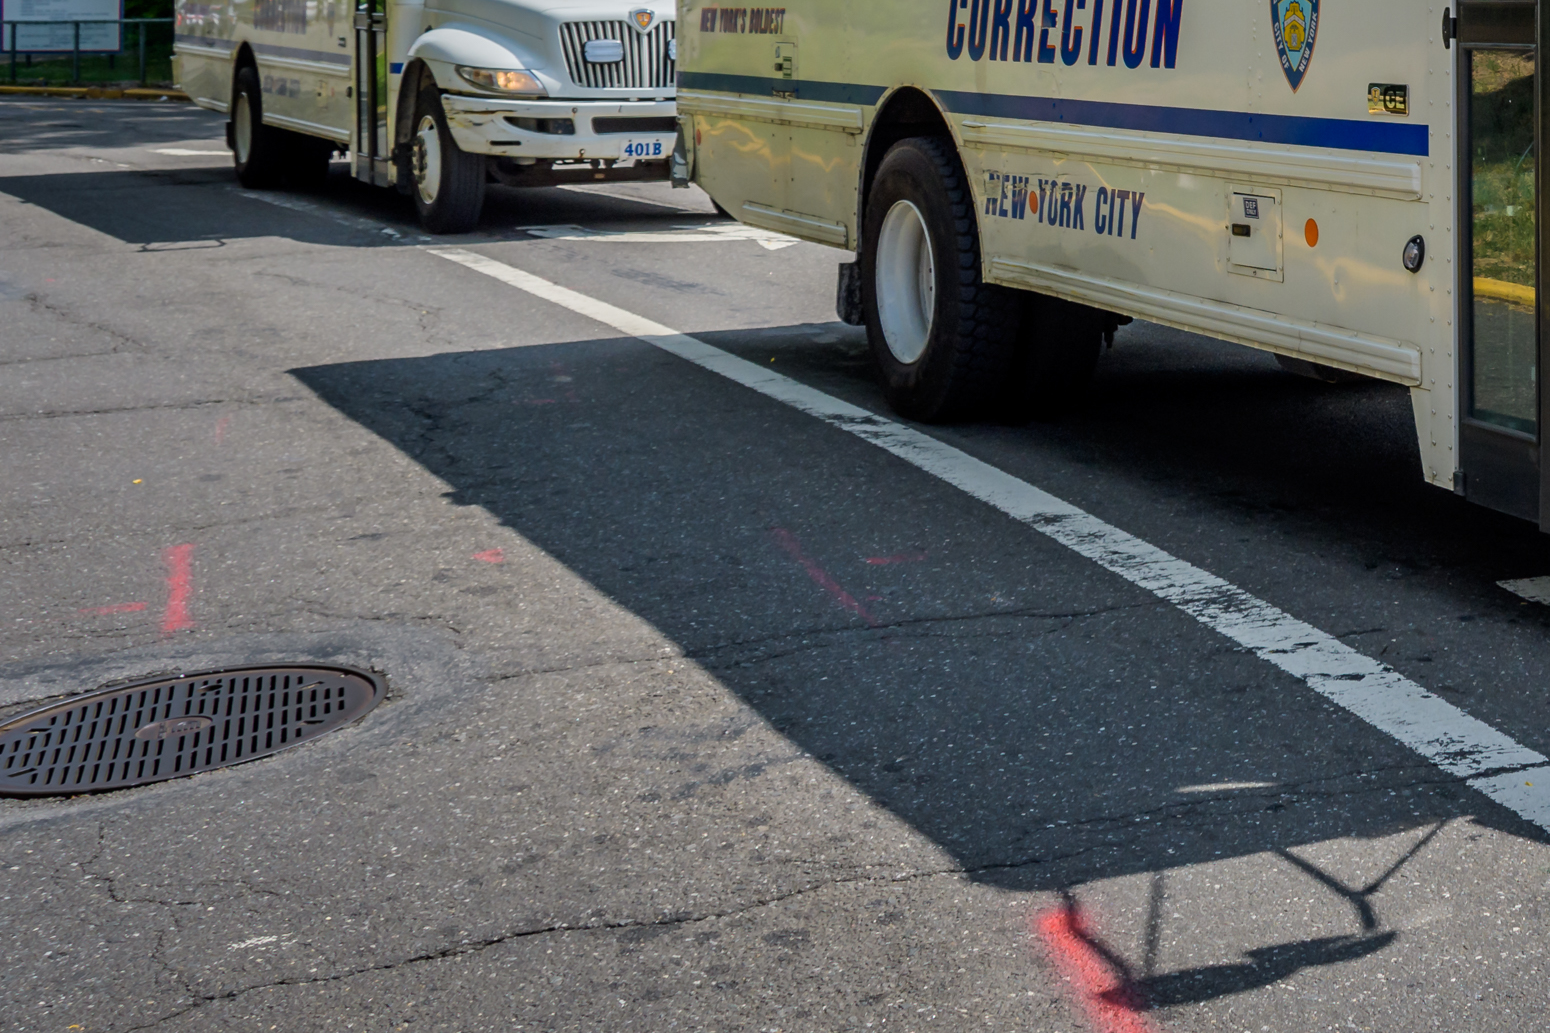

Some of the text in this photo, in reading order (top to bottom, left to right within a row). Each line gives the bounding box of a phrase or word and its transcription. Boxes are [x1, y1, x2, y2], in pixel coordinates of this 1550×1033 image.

[719, 8, 747, 34] YORK'S
[748, 8, 786, 35] BOLDEST
[1274, 21, 1290, 69] CITY OF
[1298, 11, 1318, 72] NEW YORK
[624, 143, 662, 156] 401B
[985, 172, 1145, 239] NEW YORK CITY
[1245, 201, 1256, 209] DEF
